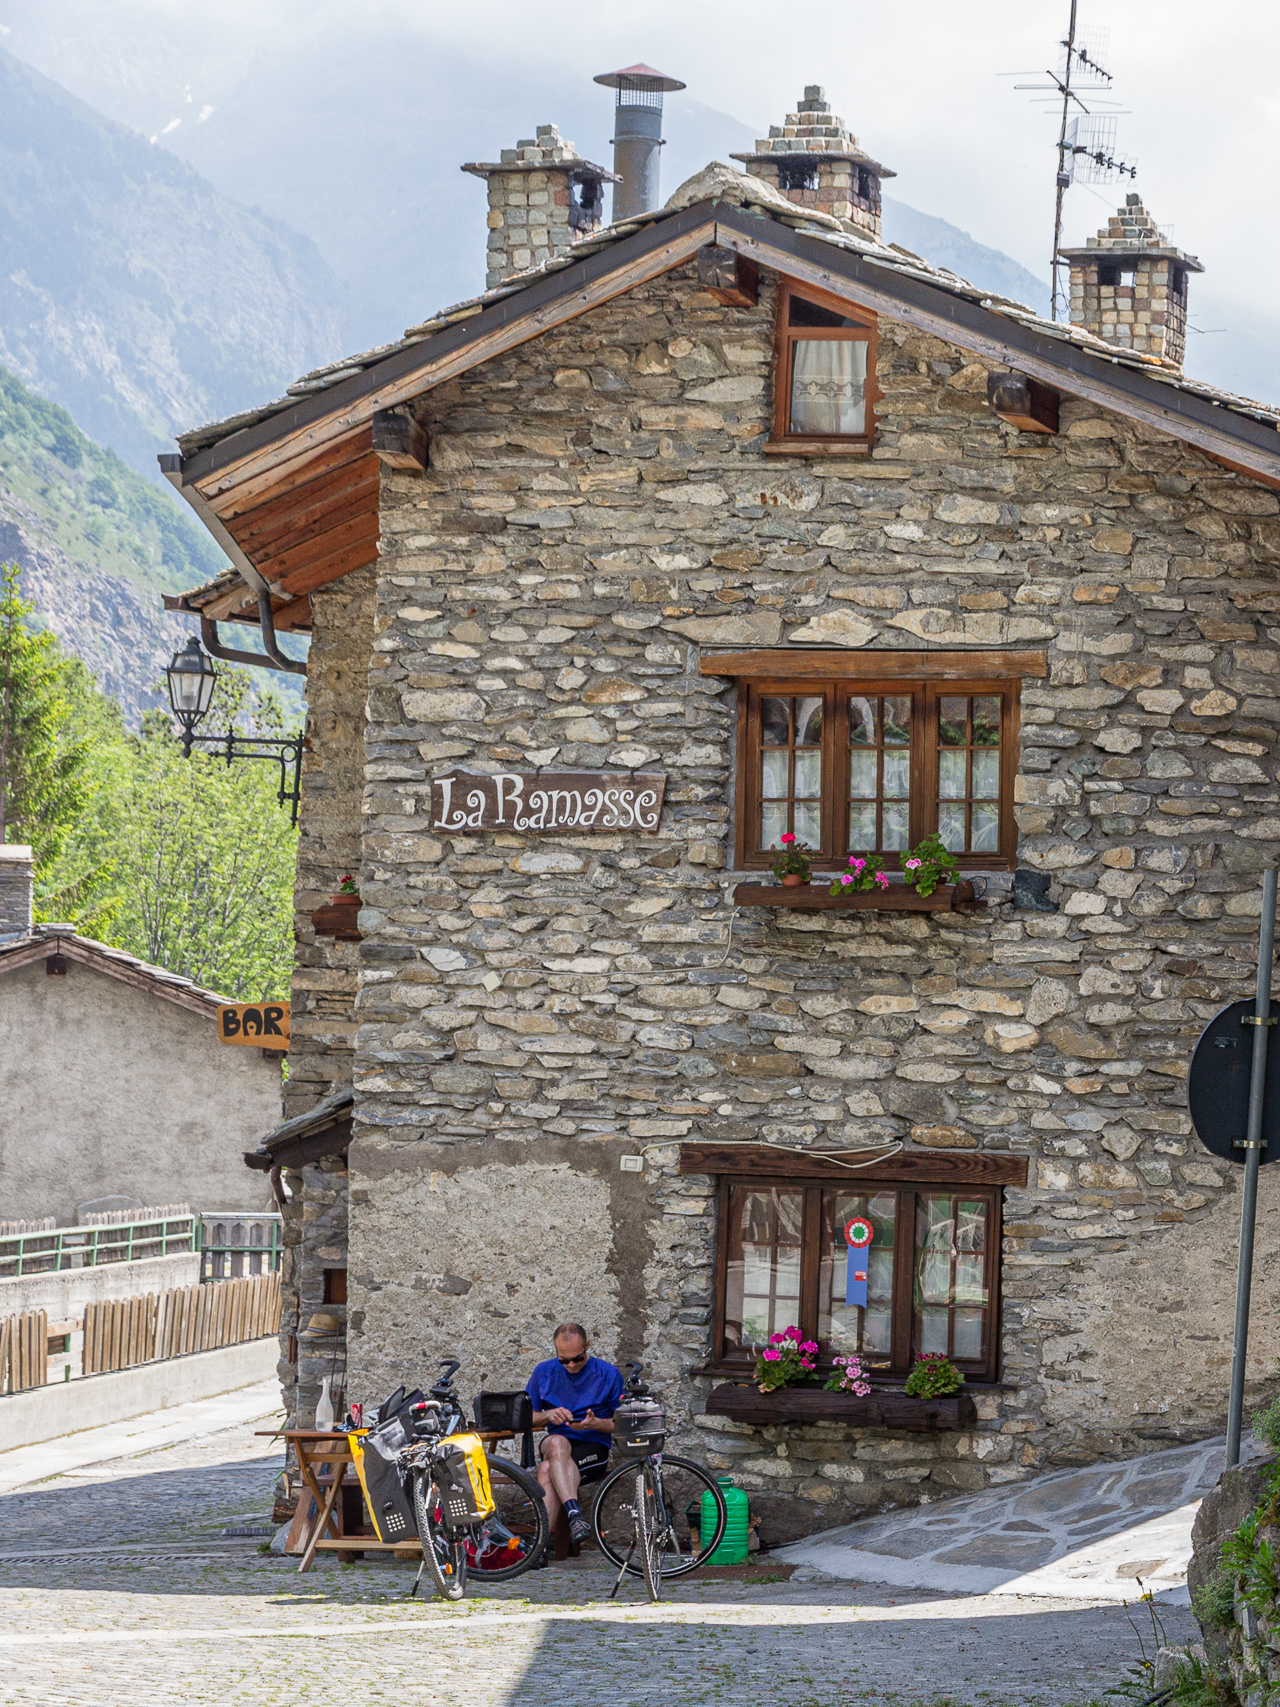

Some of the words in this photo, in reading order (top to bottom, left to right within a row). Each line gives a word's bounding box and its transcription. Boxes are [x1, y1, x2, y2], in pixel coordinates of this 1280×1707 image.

[434, 777, 486, 830] La
[491, 773, 658, 831] Ramasse
[223, 1006, 283, 1037] BAR
